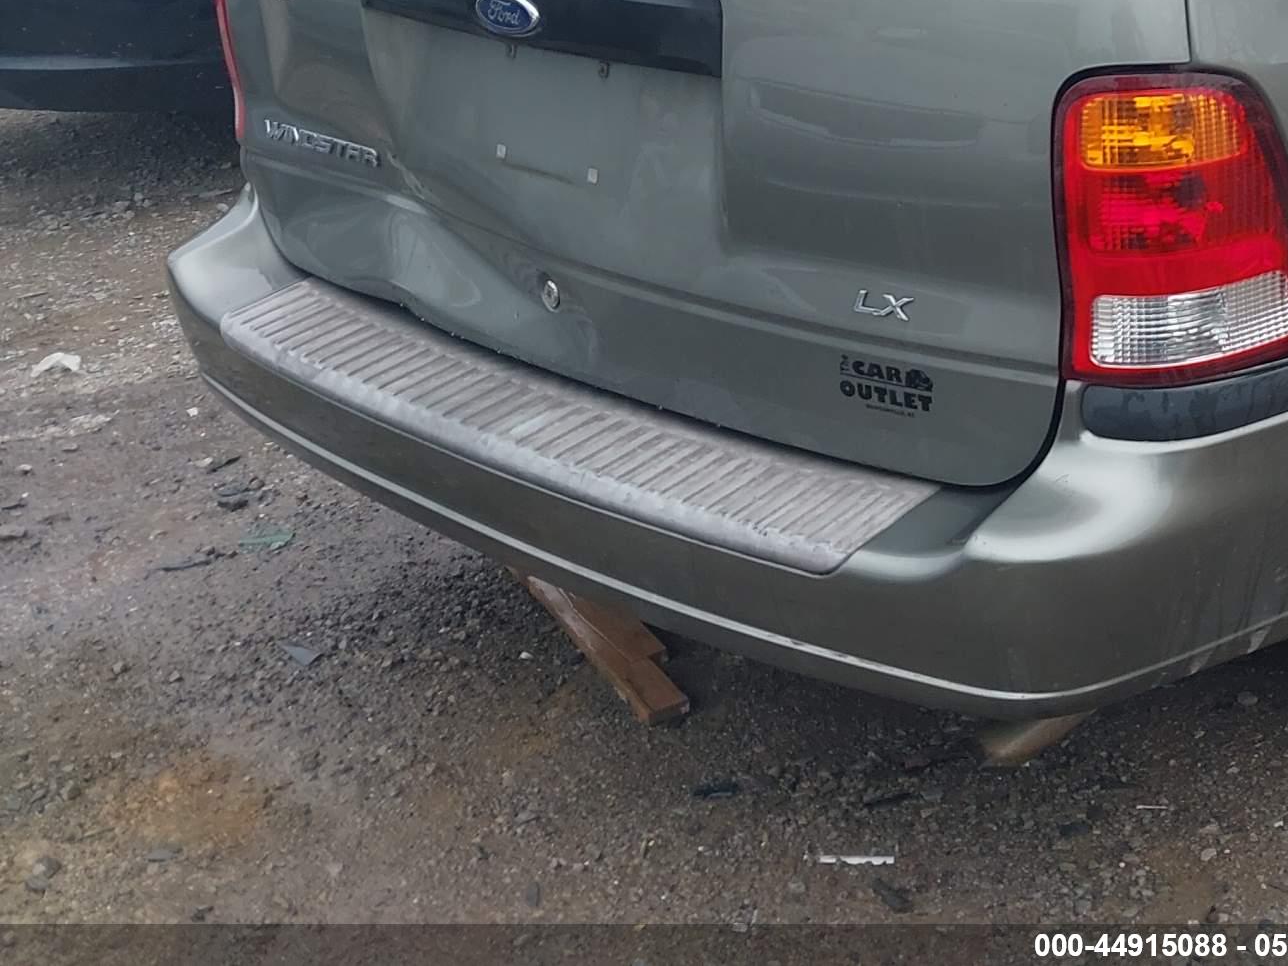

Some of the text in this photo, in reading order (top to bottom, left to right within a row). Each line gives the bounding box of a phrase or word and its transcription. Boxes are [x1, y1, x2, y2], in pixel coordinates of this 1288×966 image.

[263, 119, 379, 167] WINDSTAR
[853, 289, 915, 321] LX
[852, 360, 903, 383] CAR
[839, 379, 933, 412] OUTLET
